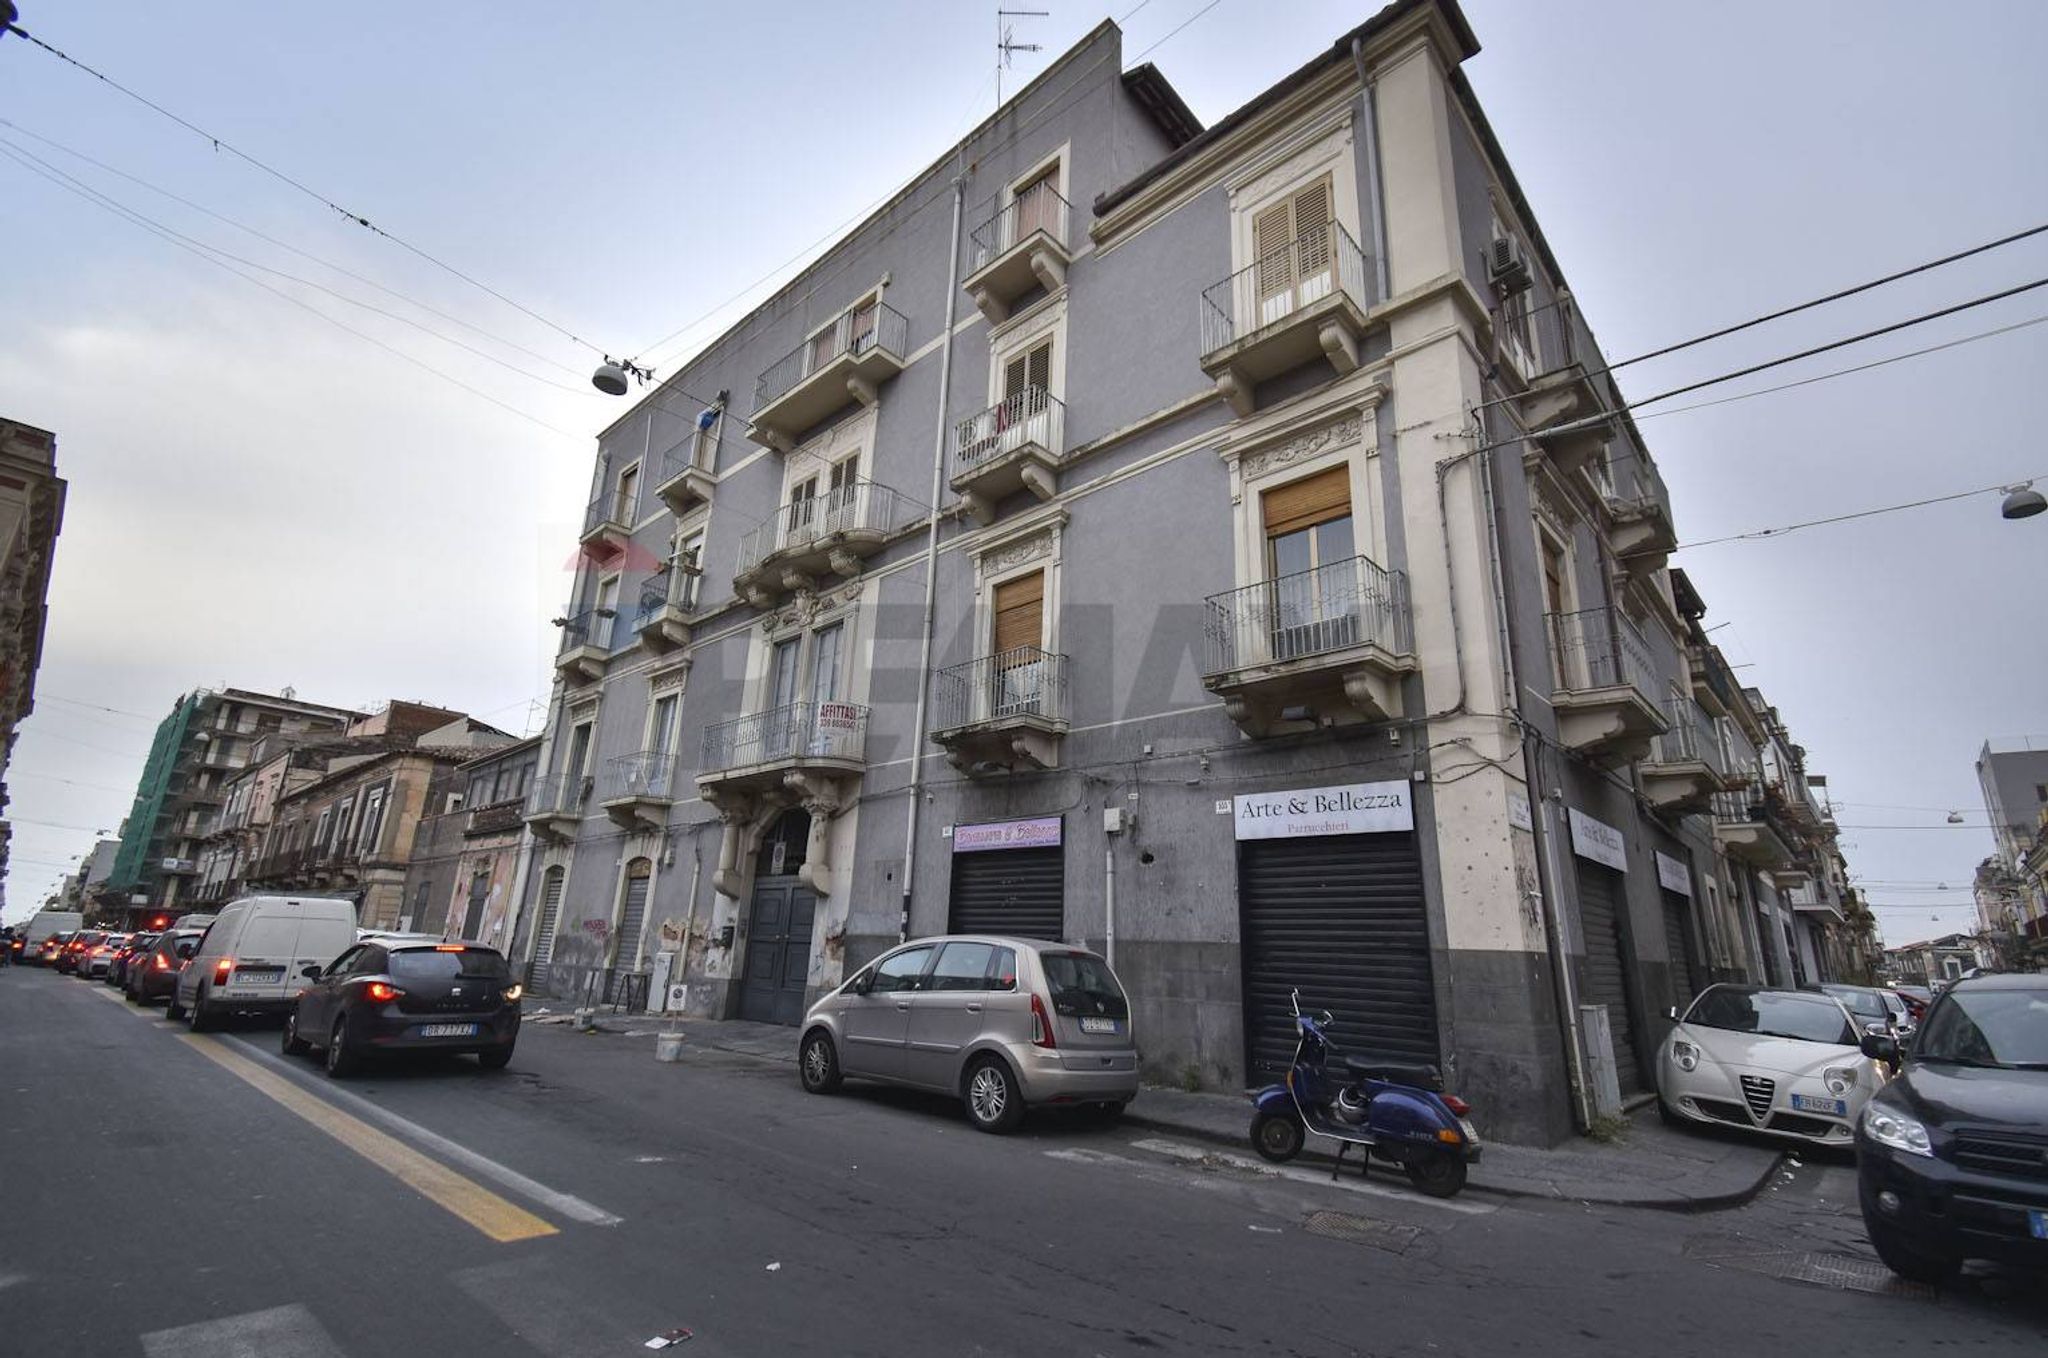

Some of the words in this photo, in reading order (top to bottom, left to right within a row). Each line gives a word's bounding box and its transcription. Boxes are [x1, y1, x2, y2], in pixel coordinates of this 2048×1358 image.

[820, 704, 857, 720] AFFITTASI
[1242, 801, 1282, 819] Arte
[1288, 798, 1308, 815] &
[1315, 791, 1402, 813] Bellezza
